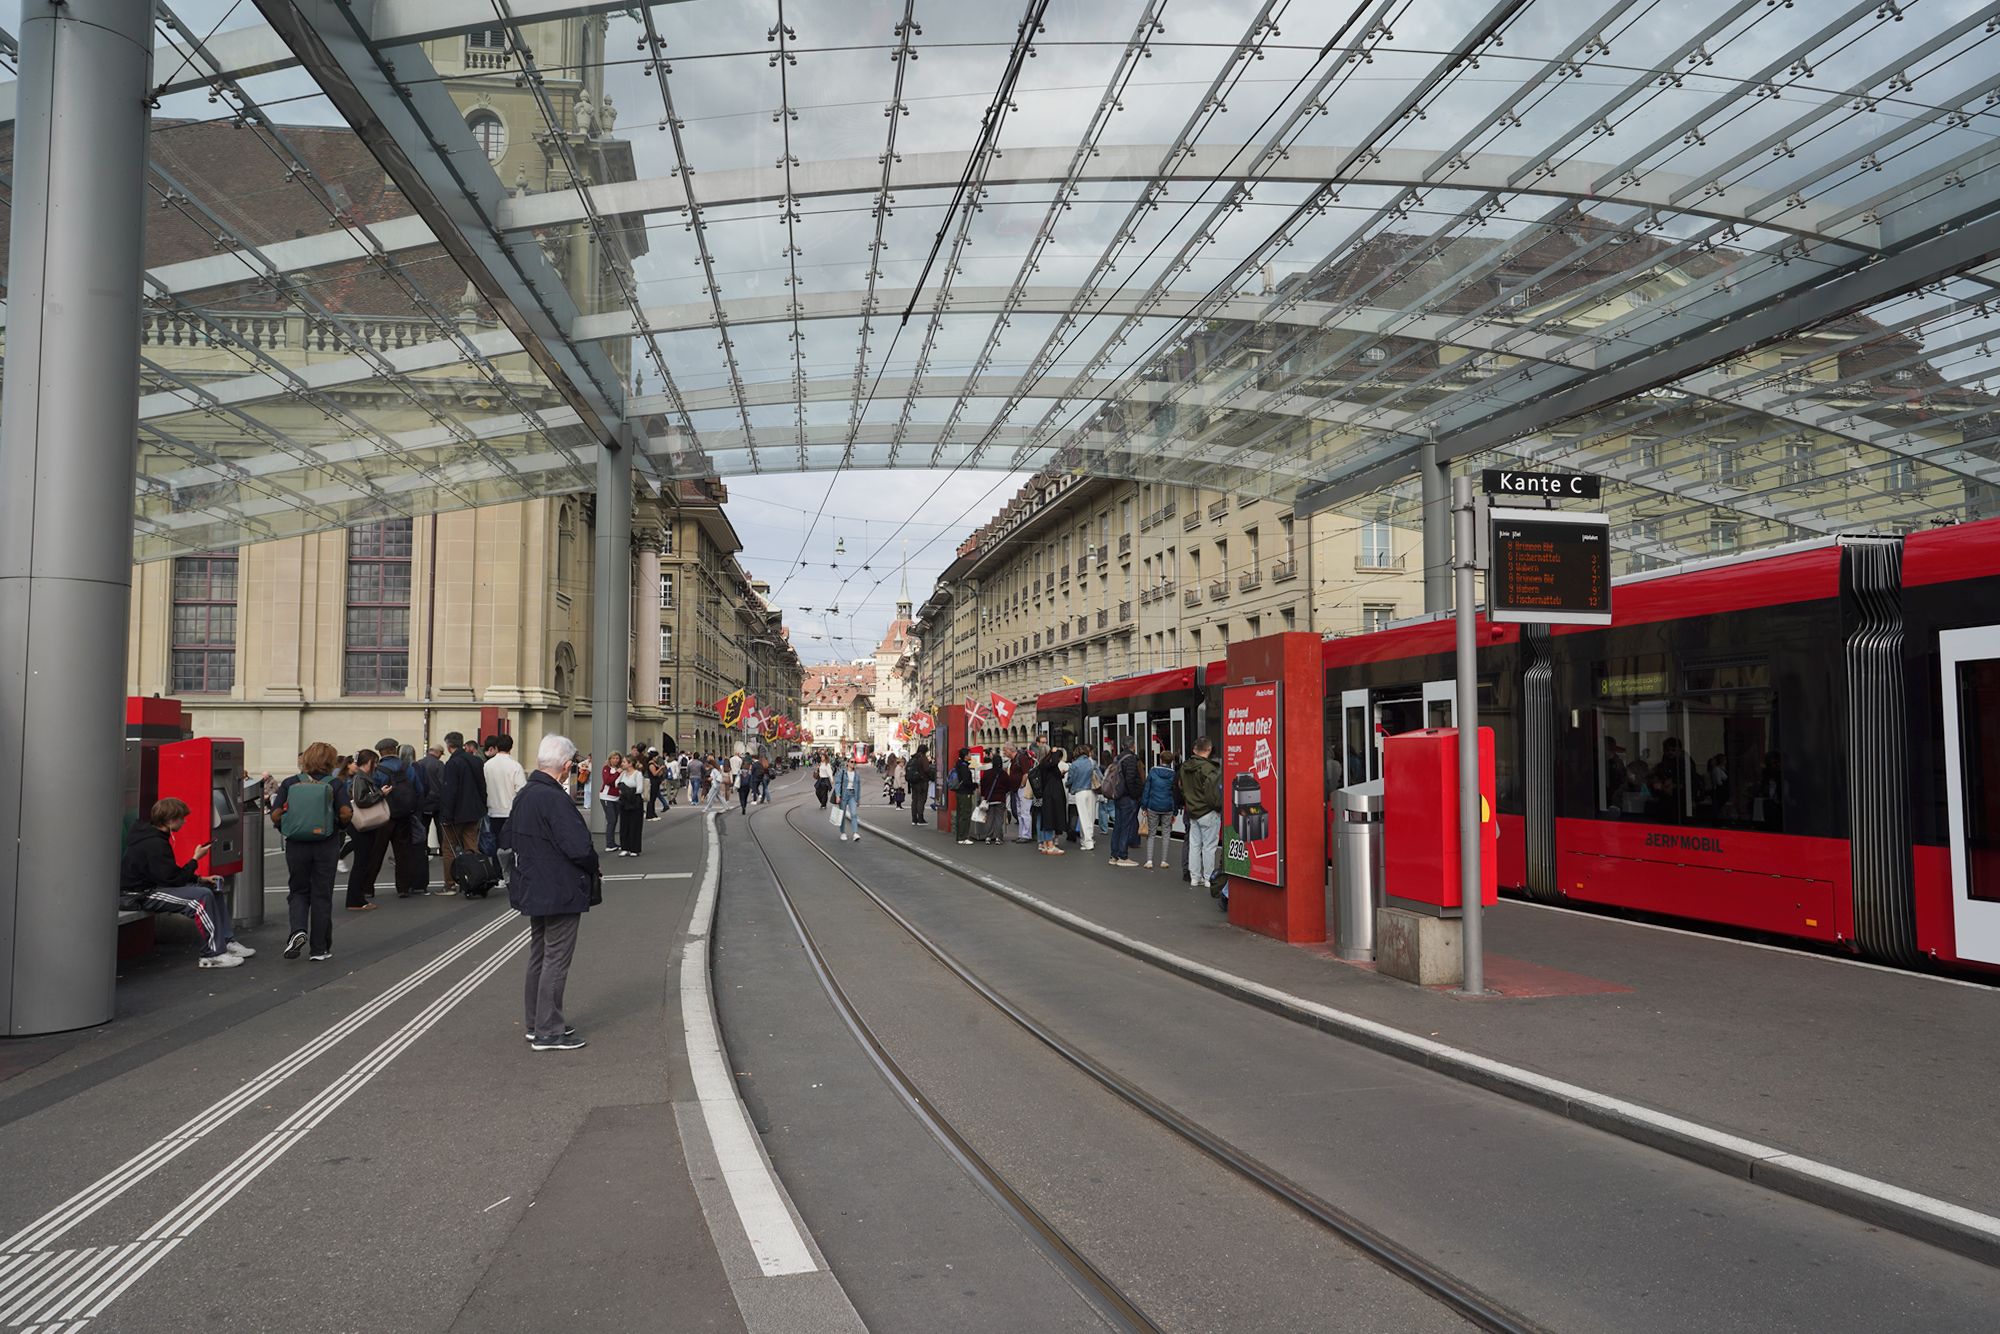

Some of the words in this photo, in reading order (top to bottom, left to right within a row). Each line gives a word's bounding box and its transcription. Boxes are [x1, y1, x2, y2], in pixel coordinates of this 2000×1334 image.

[1500, 473, 1561, 492] Kante
[1571, 477, 1582, 493] C
[1601, 679, 1608, 695] 8
[1227, 718, 1245, 736] doch
[1245, 721, 1255, 735] en
[1255, 716, 1273, 735] Ofe?
